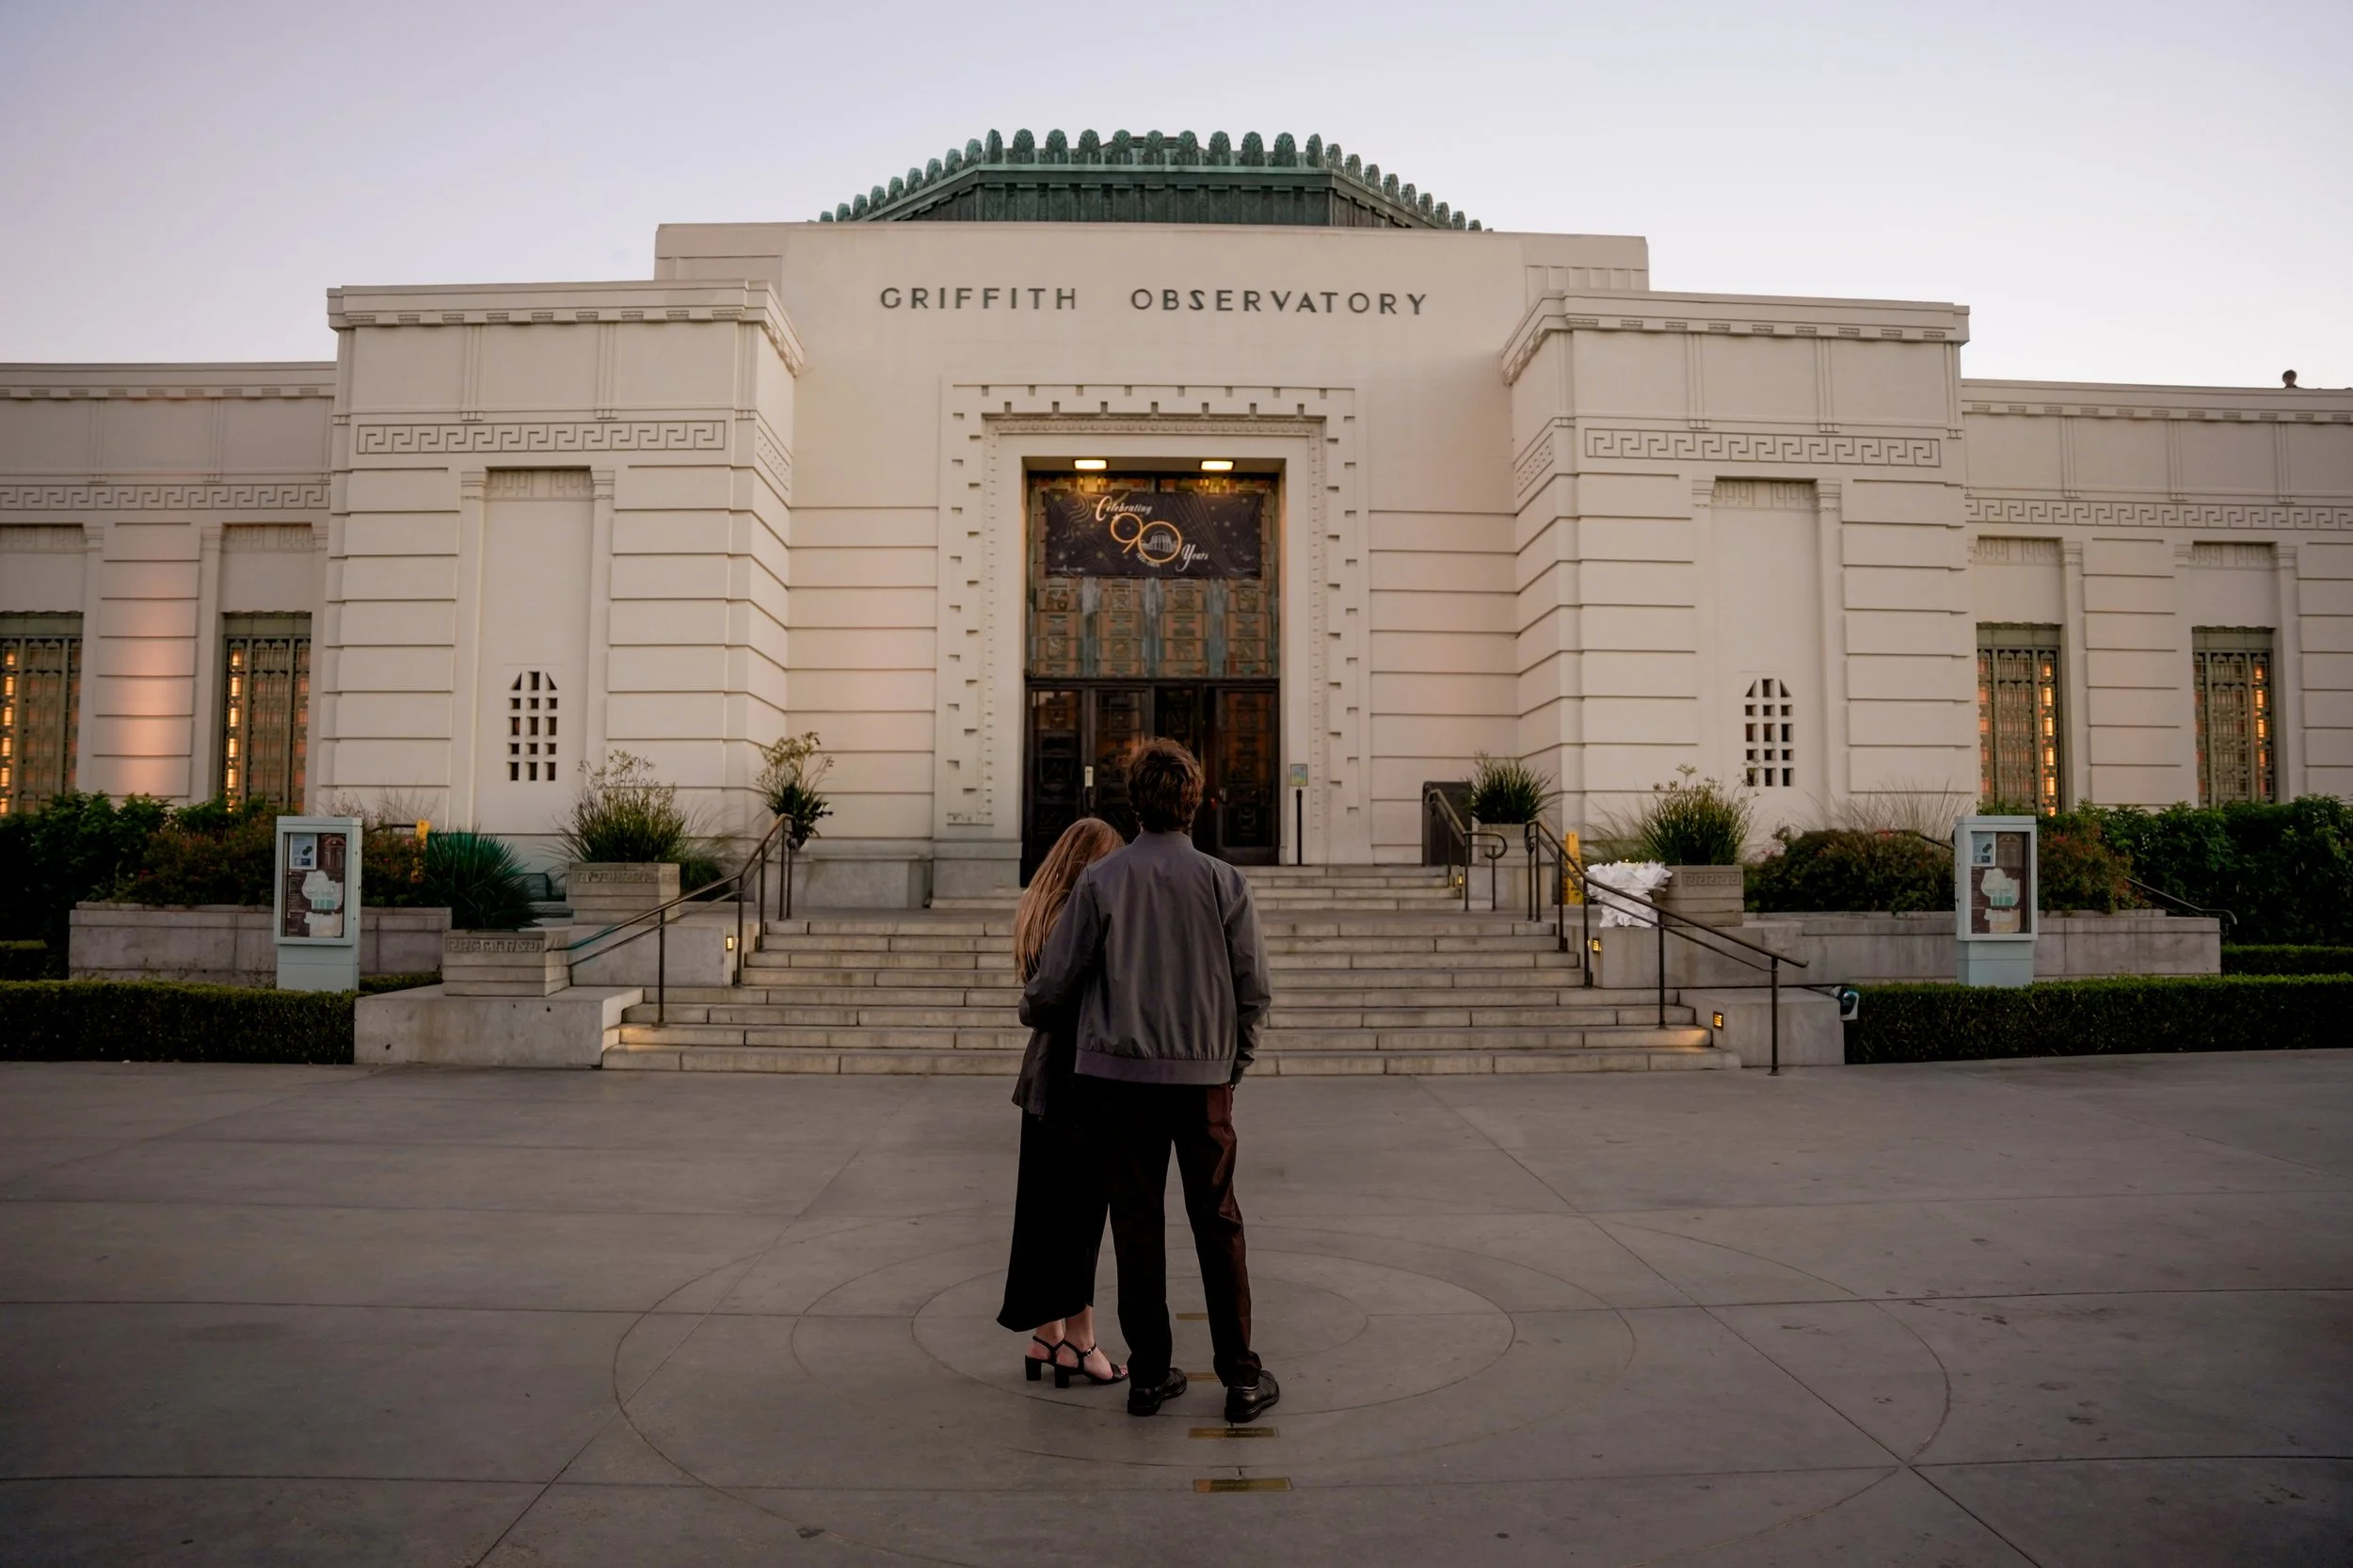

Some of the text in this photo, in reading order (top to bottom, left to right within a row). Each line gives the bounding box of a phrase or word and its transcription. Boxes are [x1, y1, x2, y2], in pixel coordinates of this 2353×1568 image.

[879, 287, 1427, 315] GRIFFITH OBSERVATORY
[1095, 495, 1153, 521] Celebrating
[1110, 512, 1182, 564] 90
[1175, 543, 1209, 572] Years
